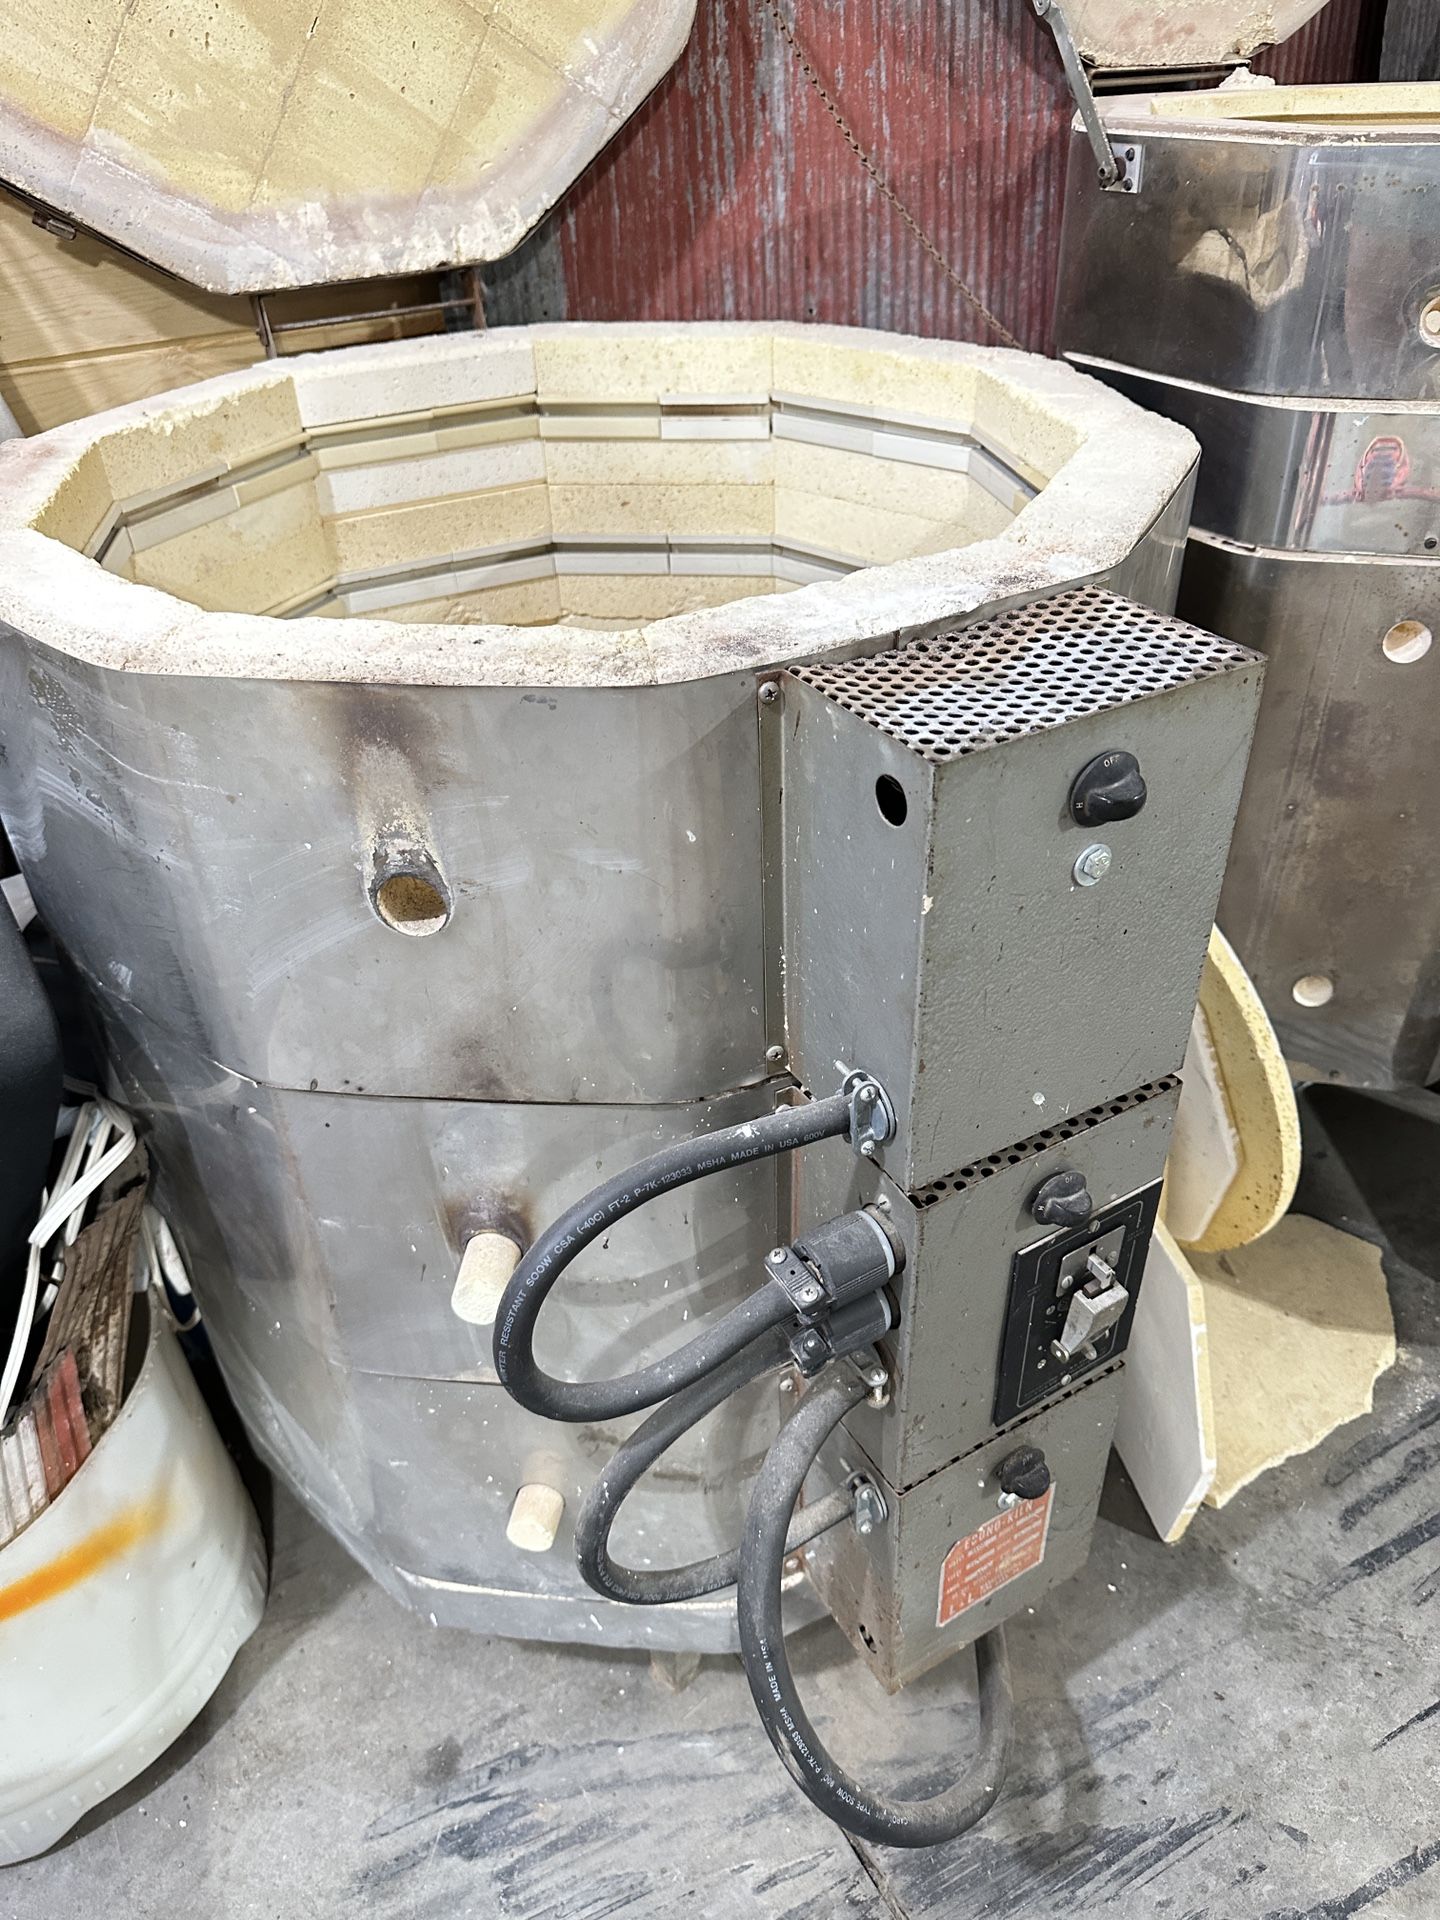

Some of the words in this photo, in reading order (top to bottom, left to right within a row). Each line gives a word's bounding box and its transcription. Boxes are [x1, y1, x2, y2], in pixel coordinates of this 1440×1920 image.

[500, 1288, 527, 1346] RESISTANT
[526, 1255, 552, 1287] SOOW
[554, 1235, 575, 1256] CSA
[576, 1210, 605, 1234] (-40C)
[607, 1195, 631, 1212] FT-2
[633, 1166, 693, 1197] P-7K-123033
[697, 1155, 726, 1170] MSHA
[731, 1147, 759, 1161] MADE
[764, 1143, 774, 1152] IN
[779, 1137, 799, 1148] USA
[804, 1130, 825, 1141] 600V
[765, 1662, 773, 1673] IN
[768, 1675, 782, 1702] MADE
[780, 1707, 795, 1730] MSHA
[836, 1788, 855, 1805] SOOW
[856, 1801, 870, 1815] TYPE
